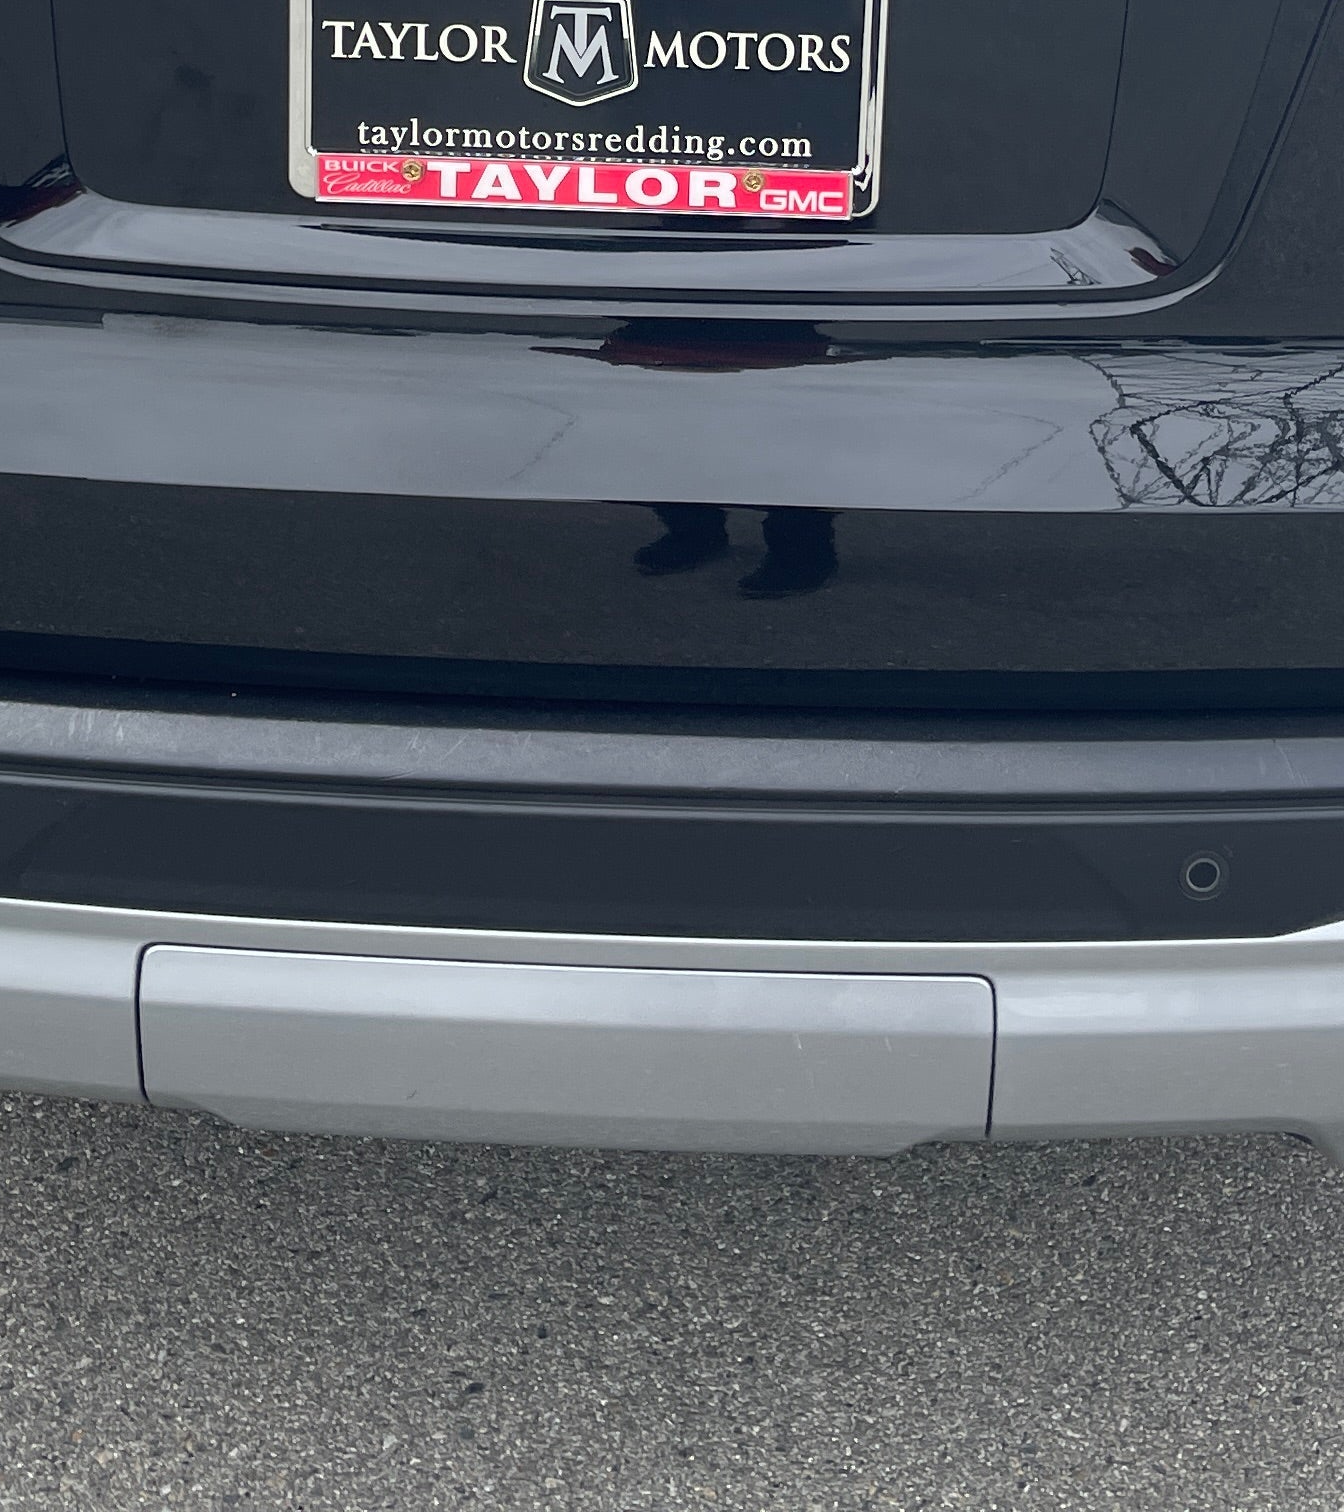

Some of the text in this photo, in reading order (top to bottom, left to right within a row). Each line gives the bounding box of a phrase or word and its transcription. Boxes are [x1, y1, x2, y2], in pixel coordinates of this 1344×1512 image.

[321, 20, 518, 64] TAYLOR
[643, 31, 852, 73] MOTORS
[357, 118, 813, 160] taylormotorsredding.com
[324, 159, 399, 172] BUICK
[322, 172, 412, 194] Cadillac
[426, 161, 739, 209] TAYLOR
[759, 189, 844, 213] GMC
